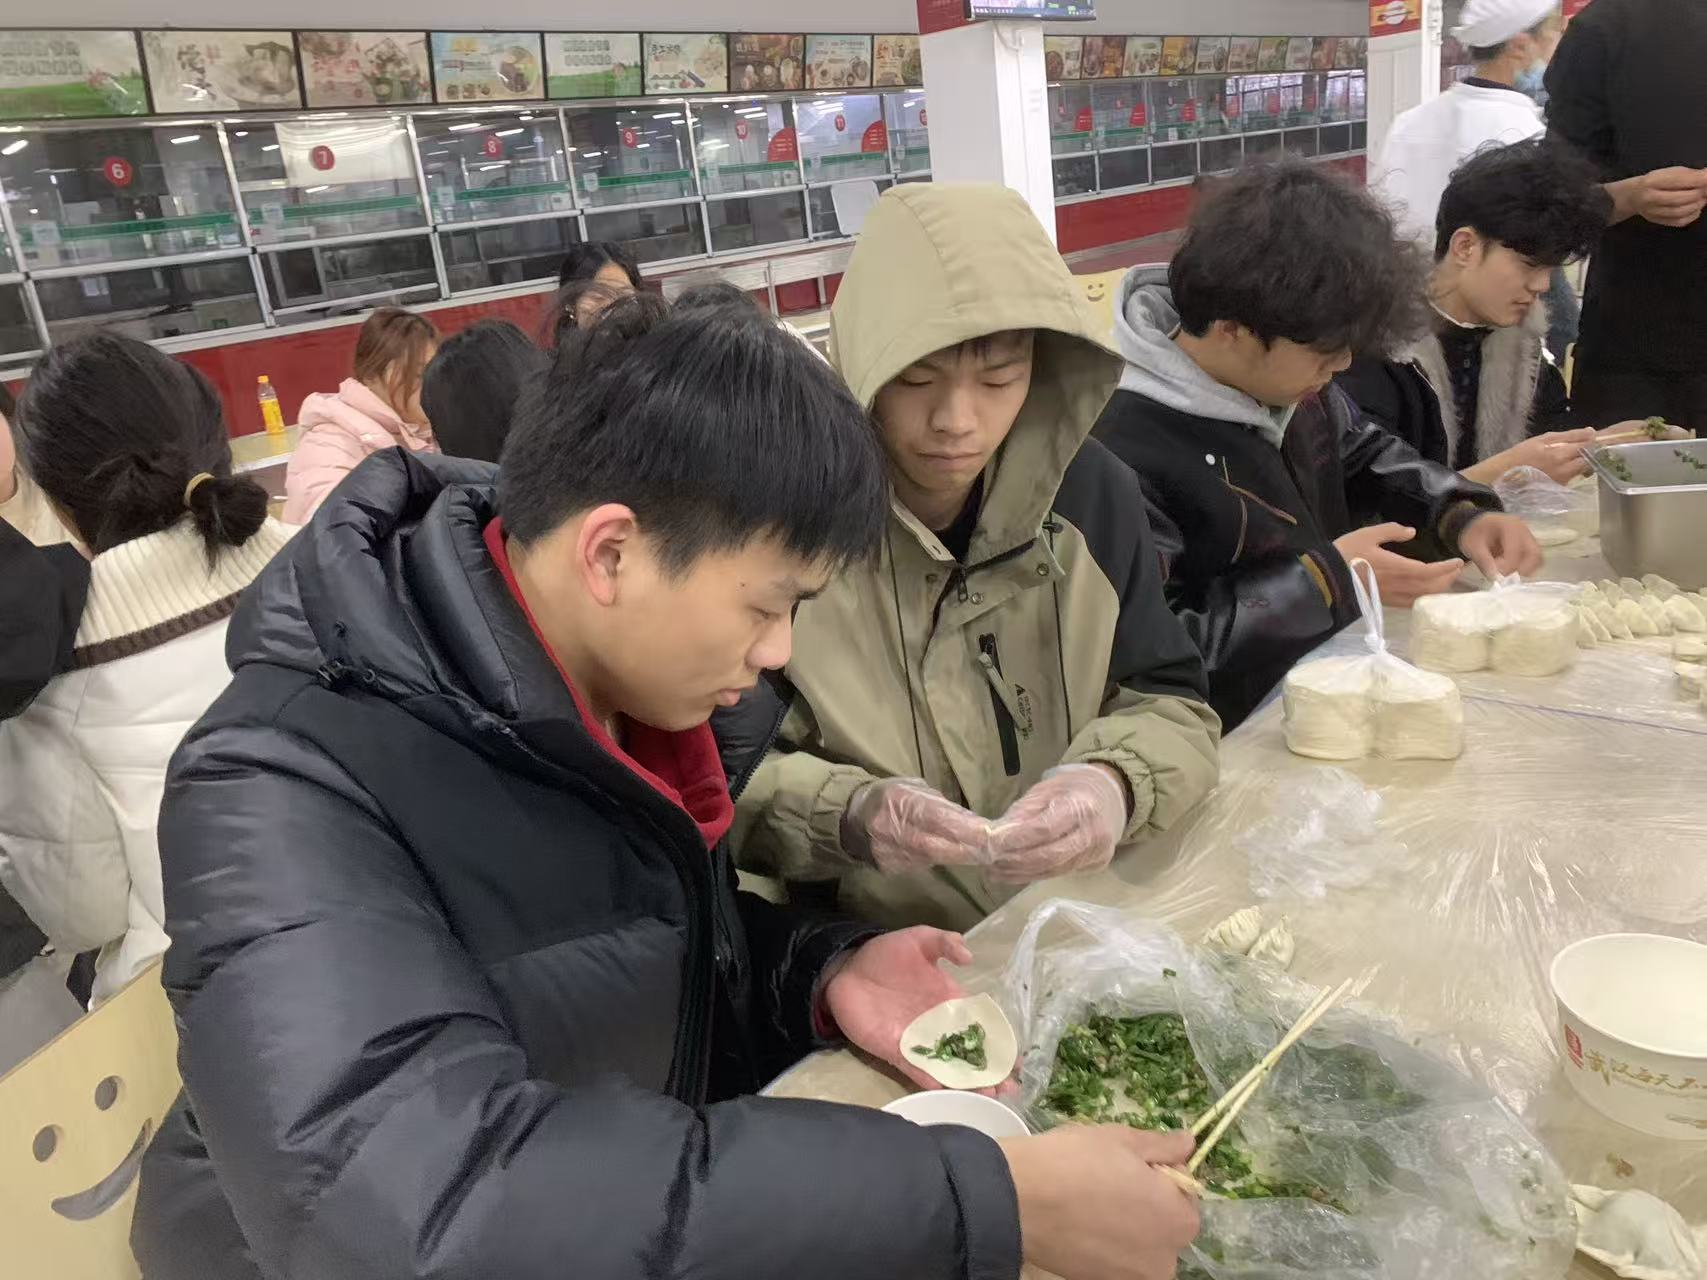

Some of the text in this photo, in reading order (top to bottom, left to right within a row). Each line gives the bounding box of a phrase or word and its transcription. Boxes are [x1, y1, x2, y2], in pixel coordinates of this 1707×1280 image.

[625, 131, 633, 144] 9
[487, 140, 497, 153] 8
[111, 163, 125, 179] 6
